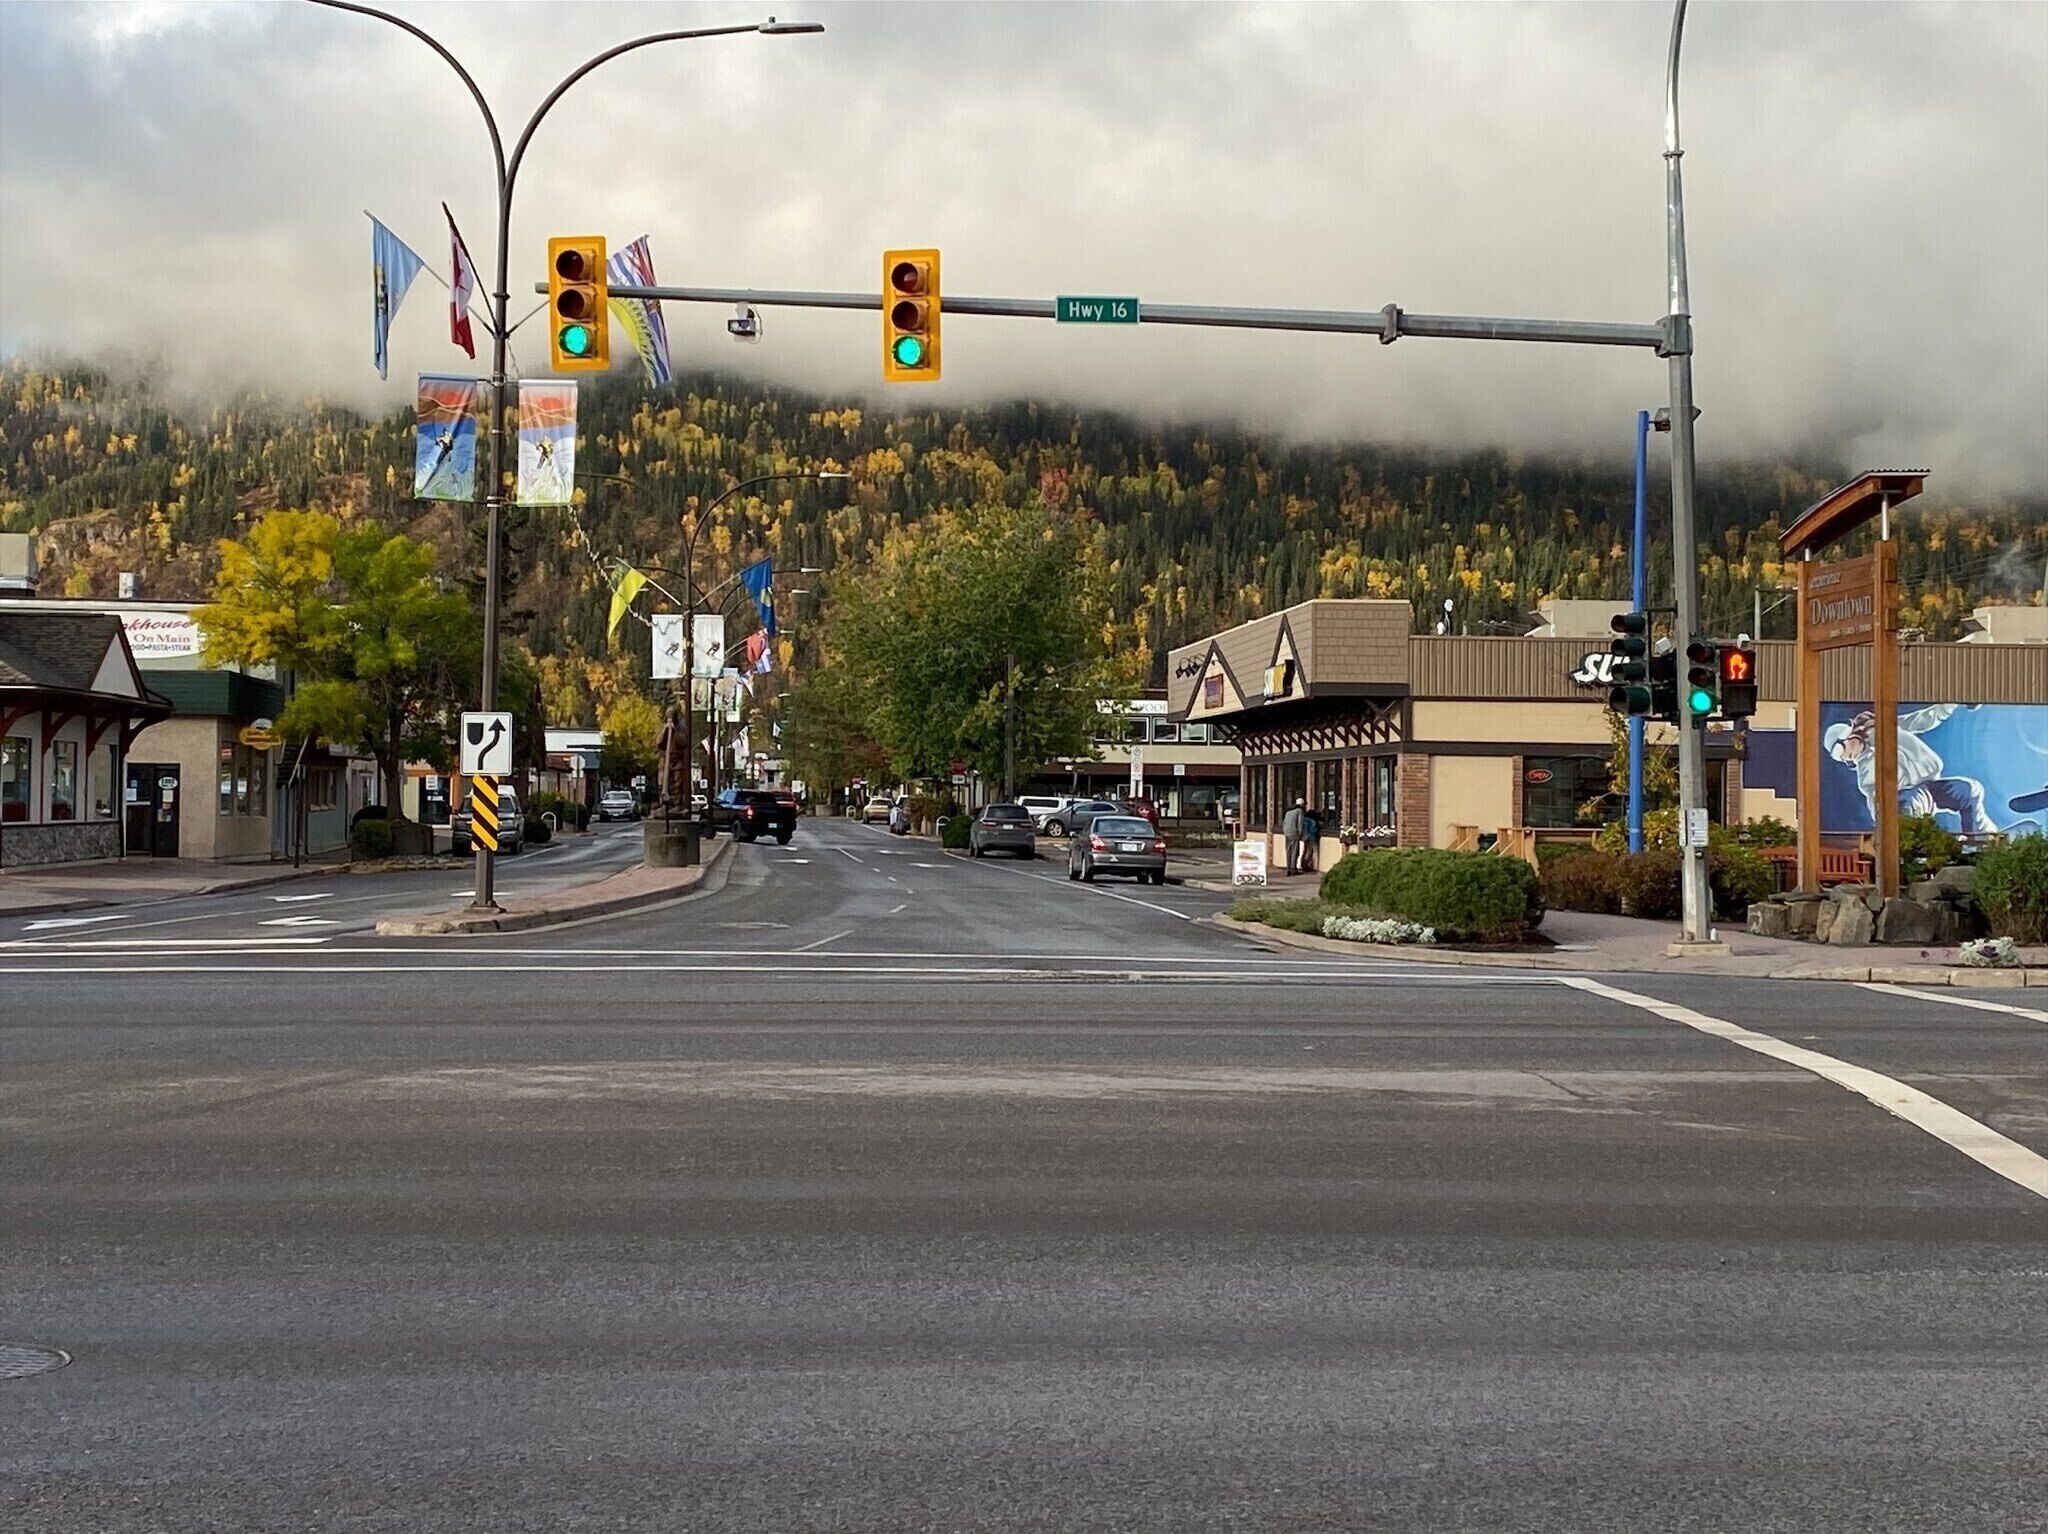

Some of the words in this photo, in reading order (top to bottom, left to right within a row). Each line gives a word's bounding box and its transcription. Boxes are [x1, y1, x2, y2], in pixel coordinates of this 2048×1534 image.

[1069, 301, 1104, 321] Hwy
[1111, 302, 1128, 318] 16
[1810, 594, 1873, 625] Downtown
[133, 633, 154, 643] On
[157, 633, 191, 643] Main
